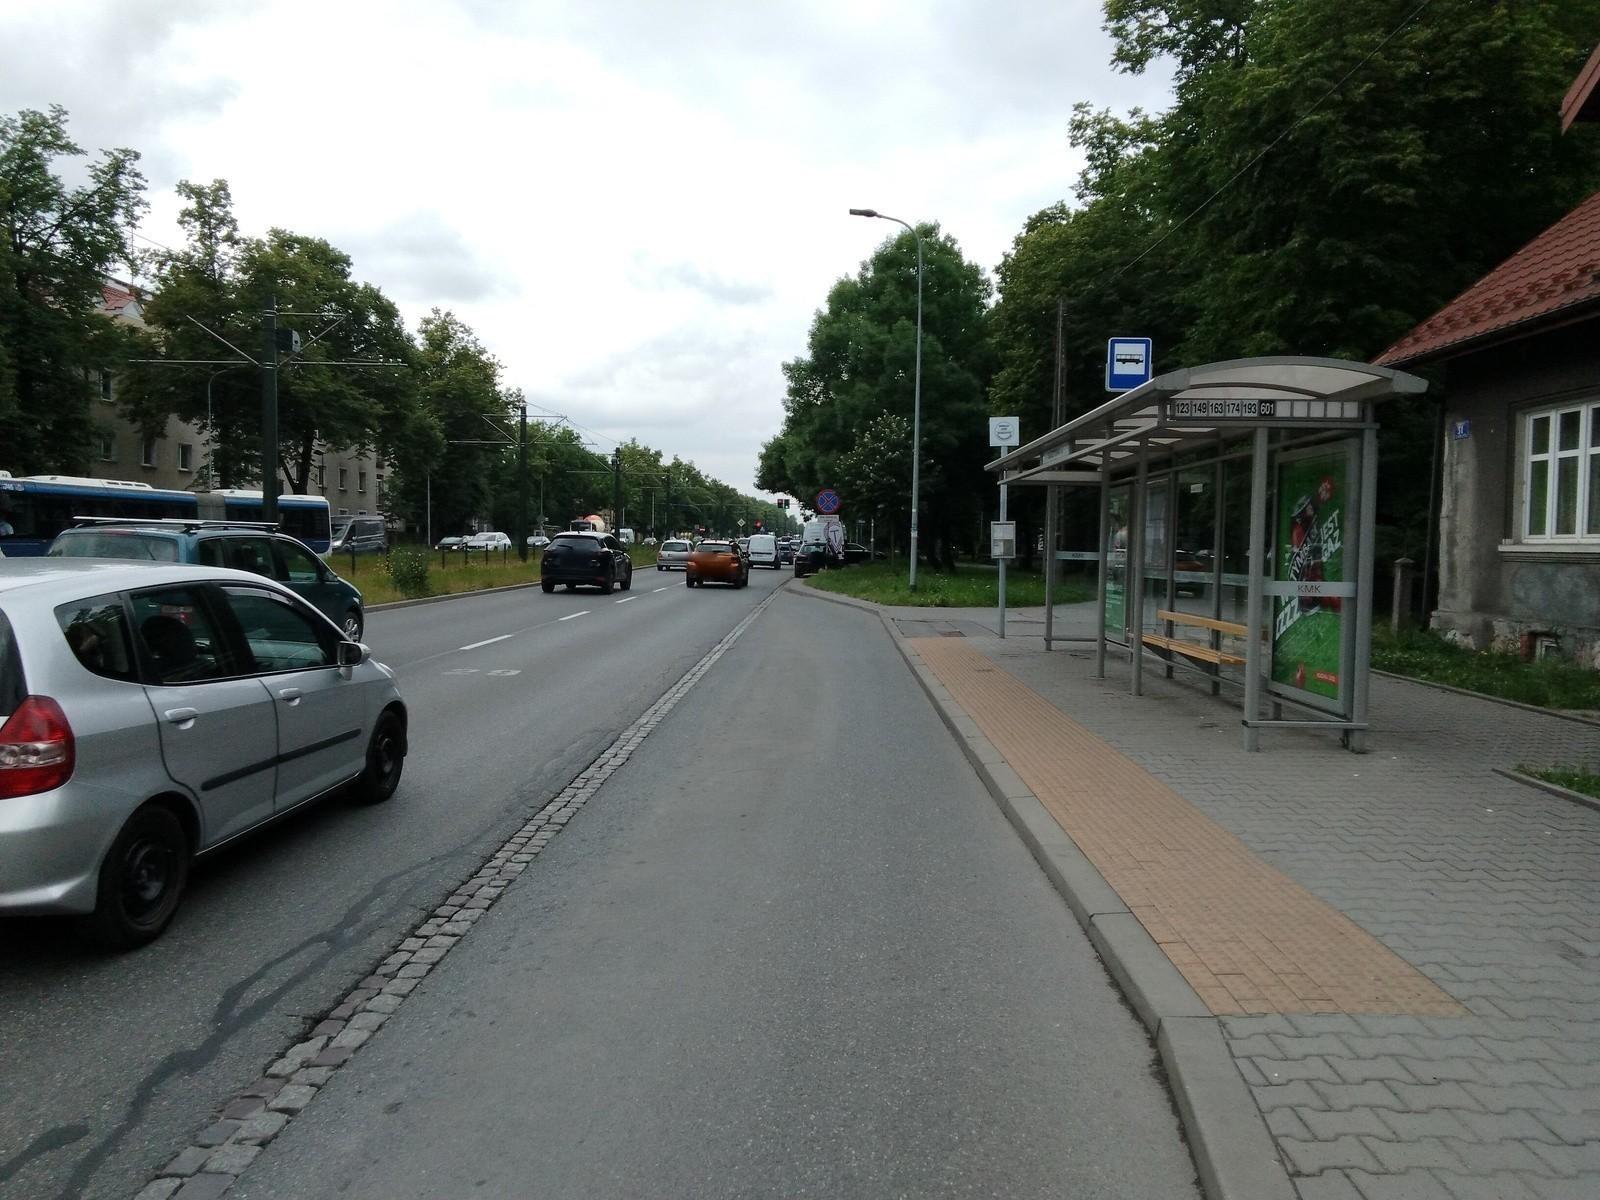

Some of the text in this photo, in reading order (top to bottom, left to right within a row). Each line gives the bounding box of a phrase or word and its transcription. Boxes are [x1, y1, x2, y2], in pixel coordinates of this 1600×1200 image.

[1176, 403, 1274, 415] 123 149 163 174 193 601
[1298, 584, 1321, 594] KMK
